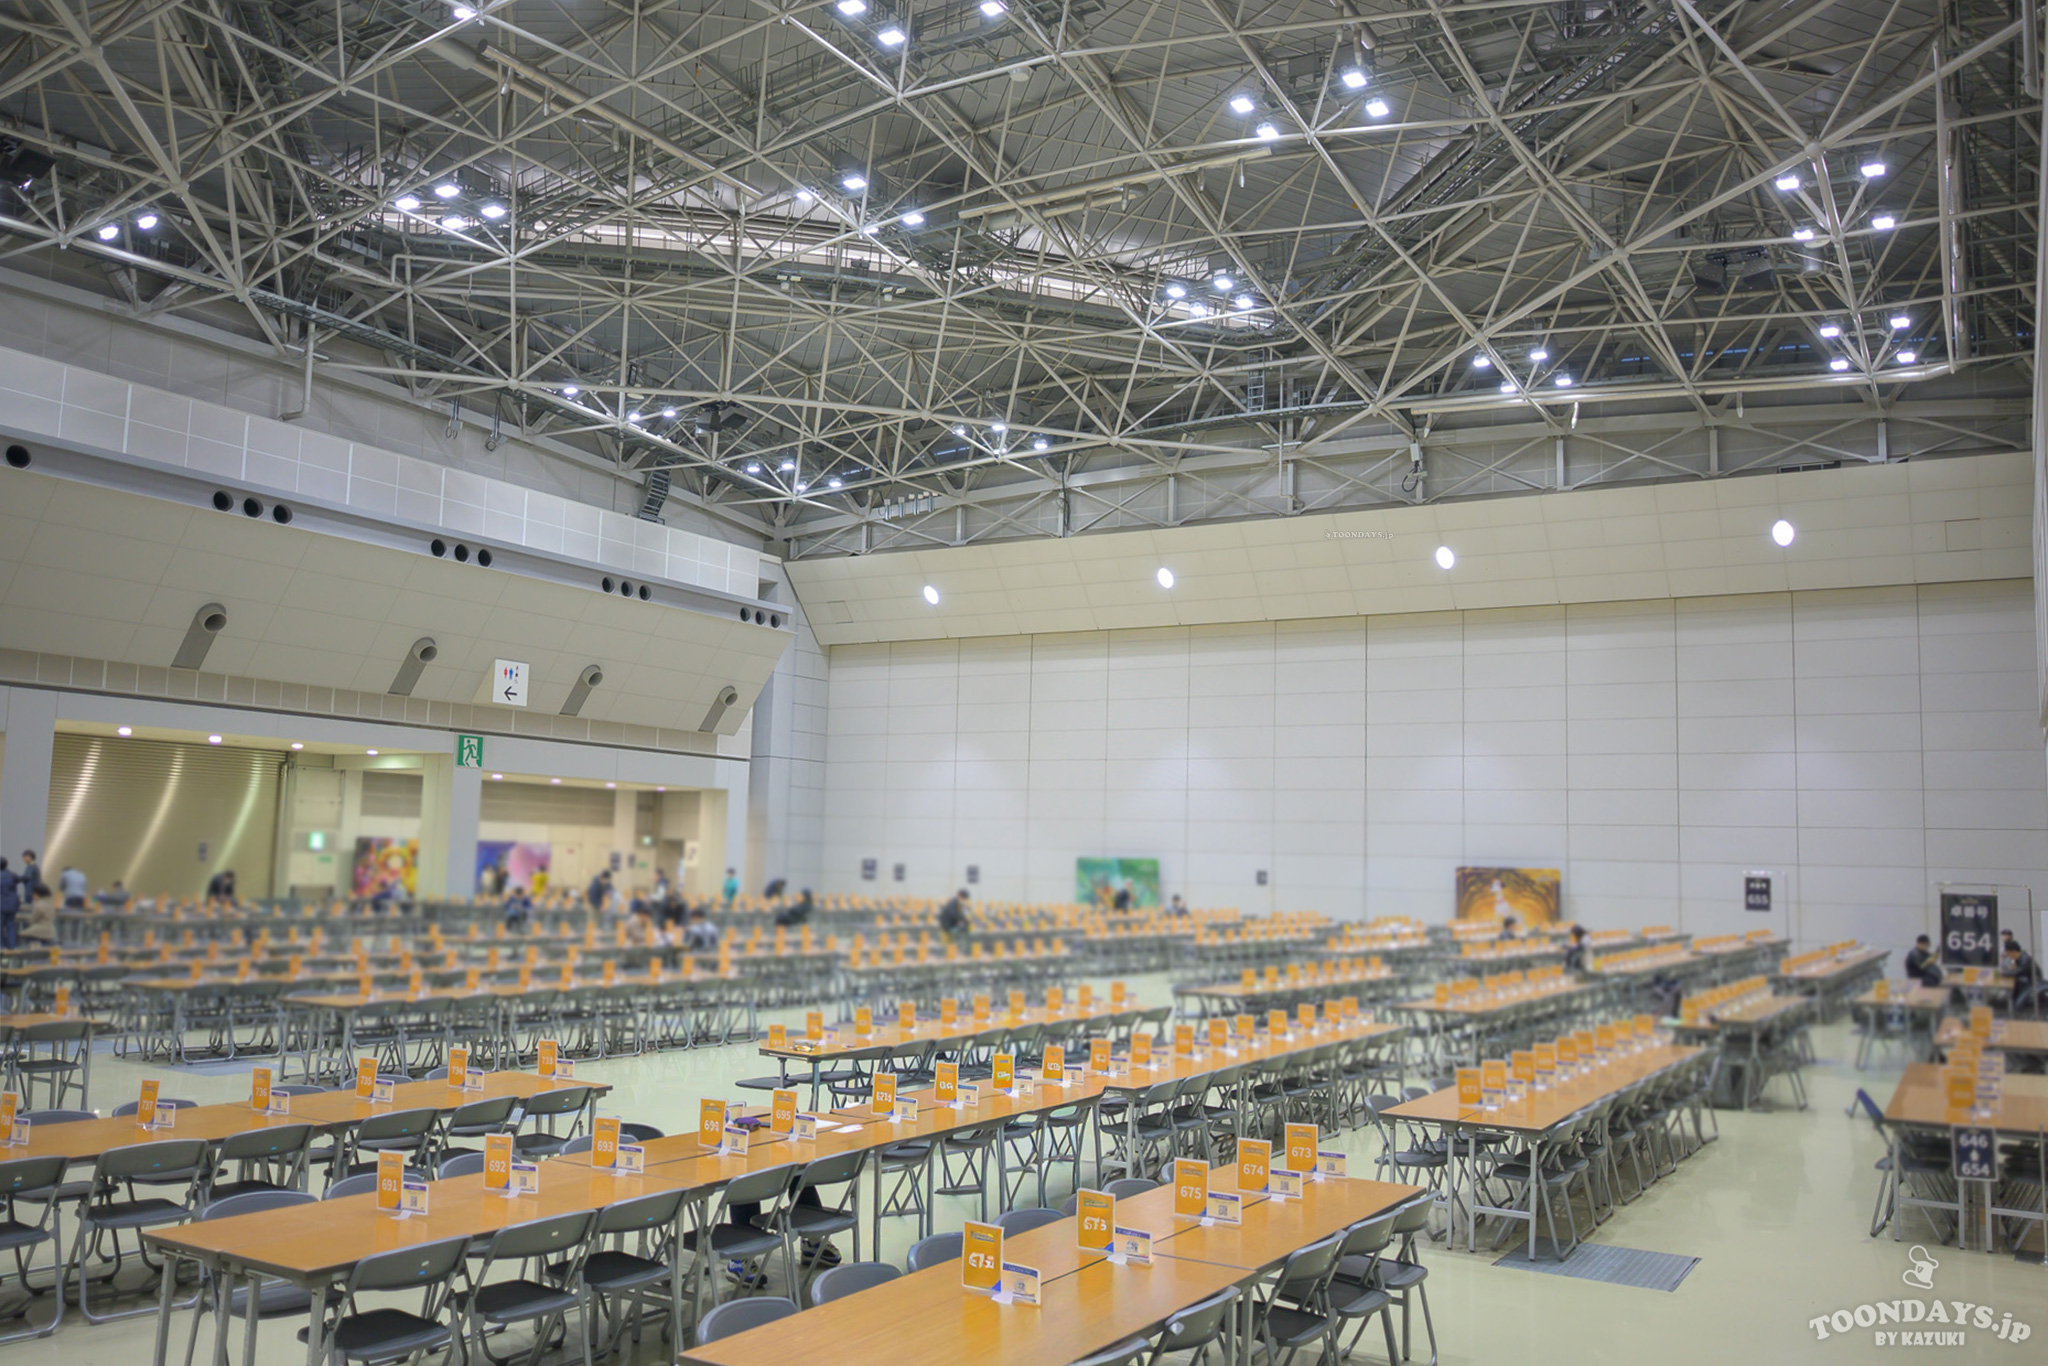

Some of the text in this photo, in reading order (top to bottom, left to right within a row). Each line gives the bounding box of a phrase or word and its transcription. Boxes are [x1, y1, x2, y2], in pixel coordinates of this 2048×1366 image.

[1947, 931, 1992, 952] 654
[452, 1066, 464, 1075] 734
[360, 1076, 372, 1086] 735
[255, 1087, 267, 1097] 736
[142, 1100, 154, 1111] 737
[776, 1109, 791, 1120] 695
[597, 1140, 614, 1152] 693
[1959, 1134, 1988, 1148] 646
[1291, 1146, 1312, 1159] 673
[489, 1160, 506, 1173] 692
[1243, 1163, 1265, 1176] 674
[1961, 1162, 1990, 1176] 654
[381, 1178, 398, 1192] 691
[1180, 1185, 1202, 1199] 675
